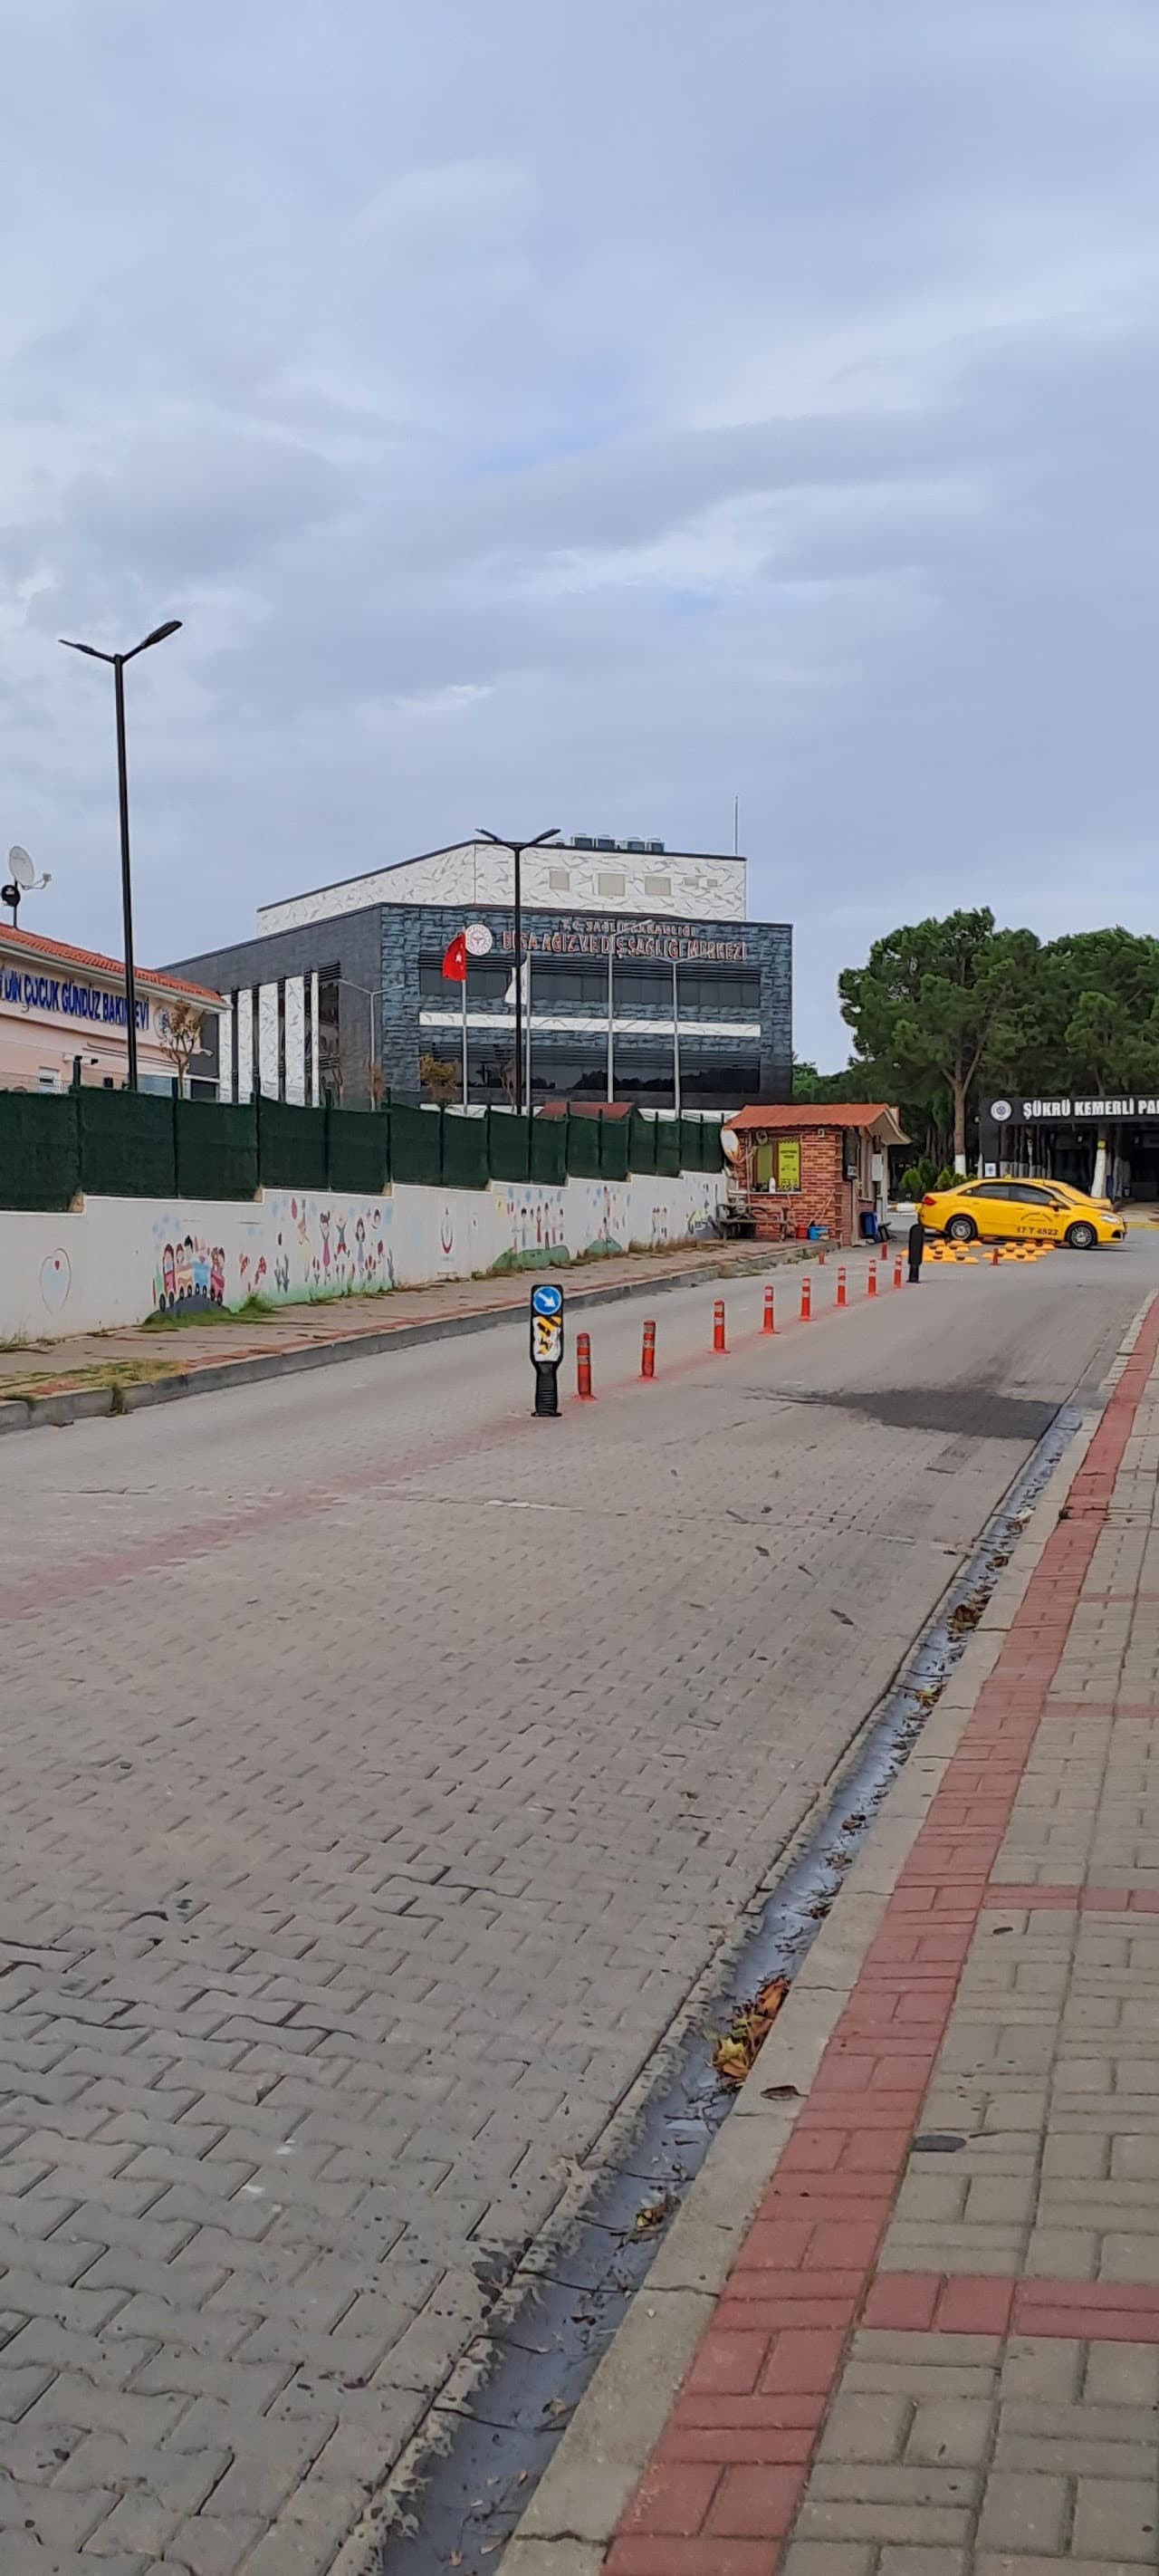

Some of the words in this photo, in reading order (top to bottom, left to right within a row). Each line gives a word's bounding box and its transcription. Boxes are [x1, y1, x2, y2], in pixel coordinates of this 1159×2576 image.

[541, 931, 577, 953] AĞIZ
[580, 934, 599, 954] VE
[23, 974, 60, 1013] ÇOCUK
[61, 979, 101, 1021] GÜNDÜZ
[102, 993, 149, 1030] BAKIEVİ
[1022, 1099, 1071, 1120] ŞÜKRÜ
[1074, 1098, 1135, 1116] KEMERLİ
